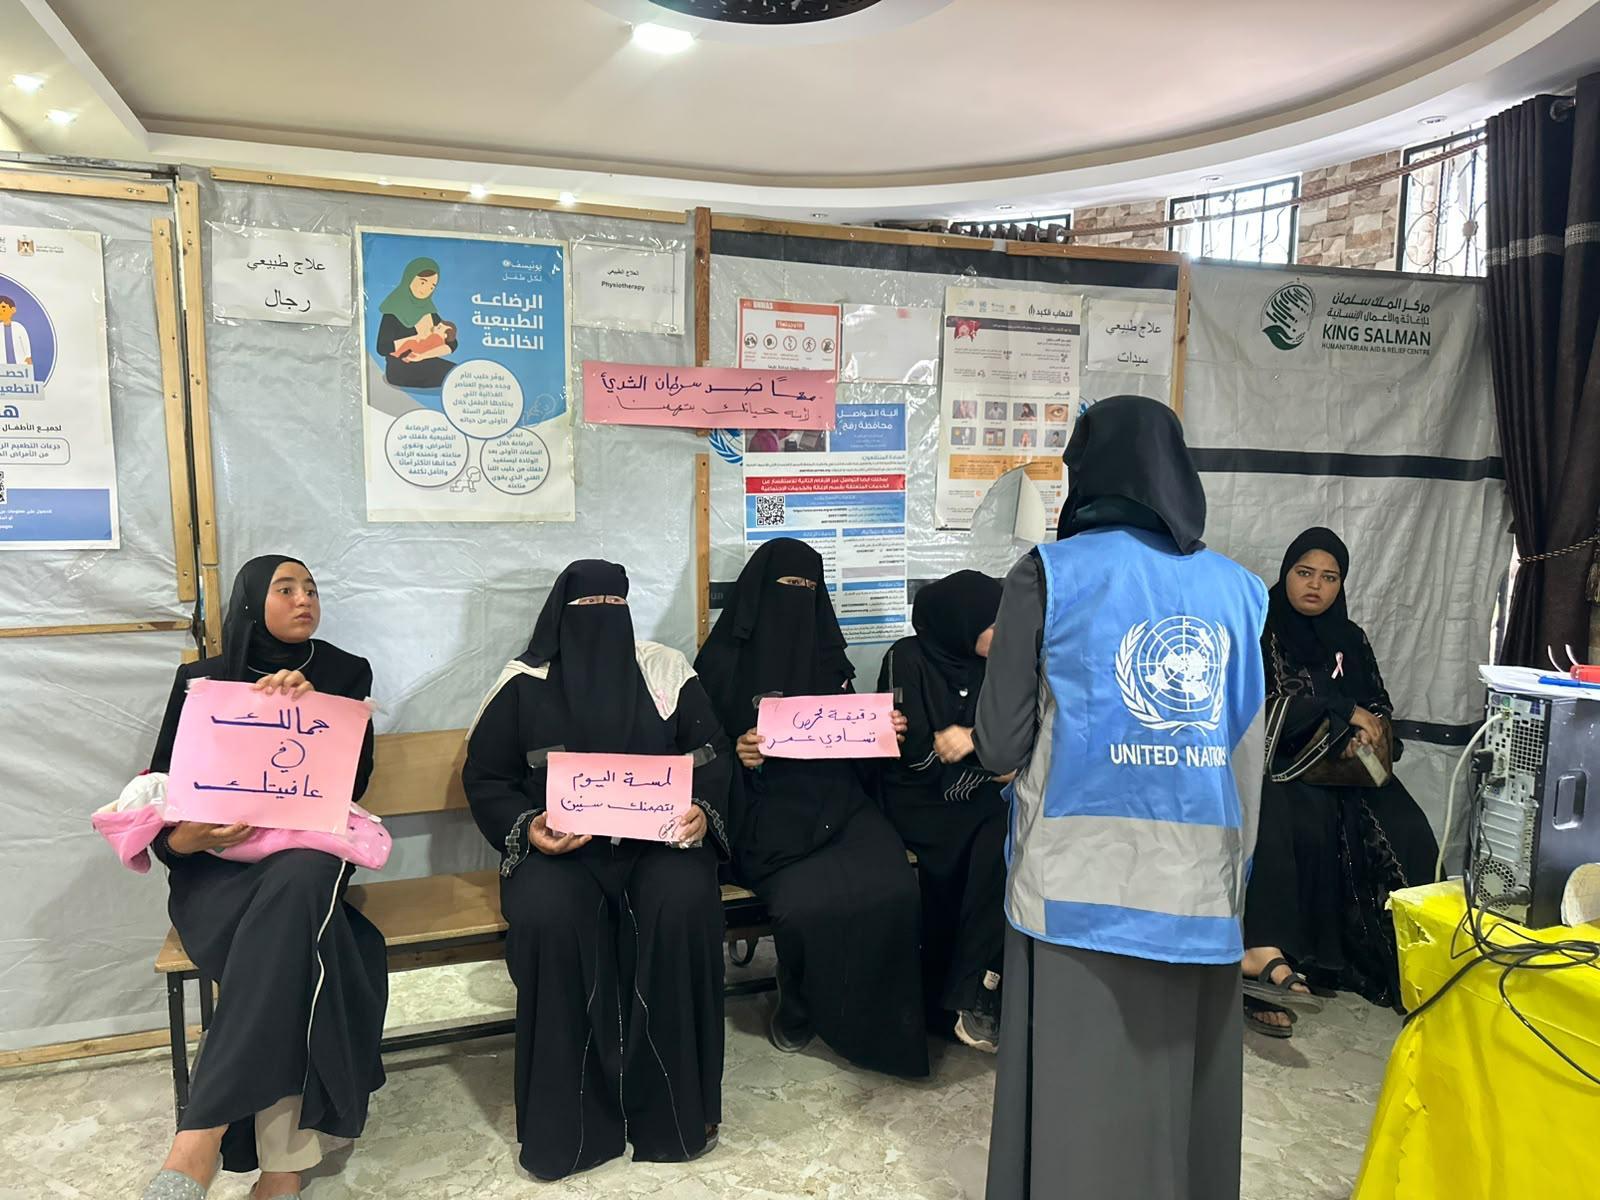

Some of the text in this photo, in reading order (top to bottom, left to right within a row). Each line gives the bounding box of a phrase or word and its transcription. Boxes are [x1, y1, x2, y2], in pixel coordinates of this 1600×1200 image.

[246, 254, 326, 275] علاج طبيعي
[502, 272, 543, 283] لكل طفل
[601, 280, 646, 292] Physiotherapy
[264, 288, 311, 313] رجال
[1332, 291, 1431, 313] مركز الملك سلمان
[471, 310, 544, 332] الطبيعية
[1105, 319, 1162, 339] علاج طبيعي
[482, 332, 544, 351] الخالصة
[1322, 323, 1431, 347] KING SALMAN
[1117, 351, 1149, 367] سيدات
[1321, 342, 1369, 352] HUMANITARIAN
[1387, 346, 1406, 354] RELIEF
[1406, 348, 1430, 356] CENTRE
[655, 372, 702, 396] سرطان
[836, 409, 880, 419] التواصل
[842, 421, 894, 431] محافظة رفح
[210, 706, 330, 735] جمالك
[828, 708, 877, 725] دقيقة
[767, 728, 876, 749] تساوي عمر
[1110, 743, 1179, 767] UNITED
[193, 771, 323, 799] عافيتك
[572, 767, 671, 791] لمسة اليوم
